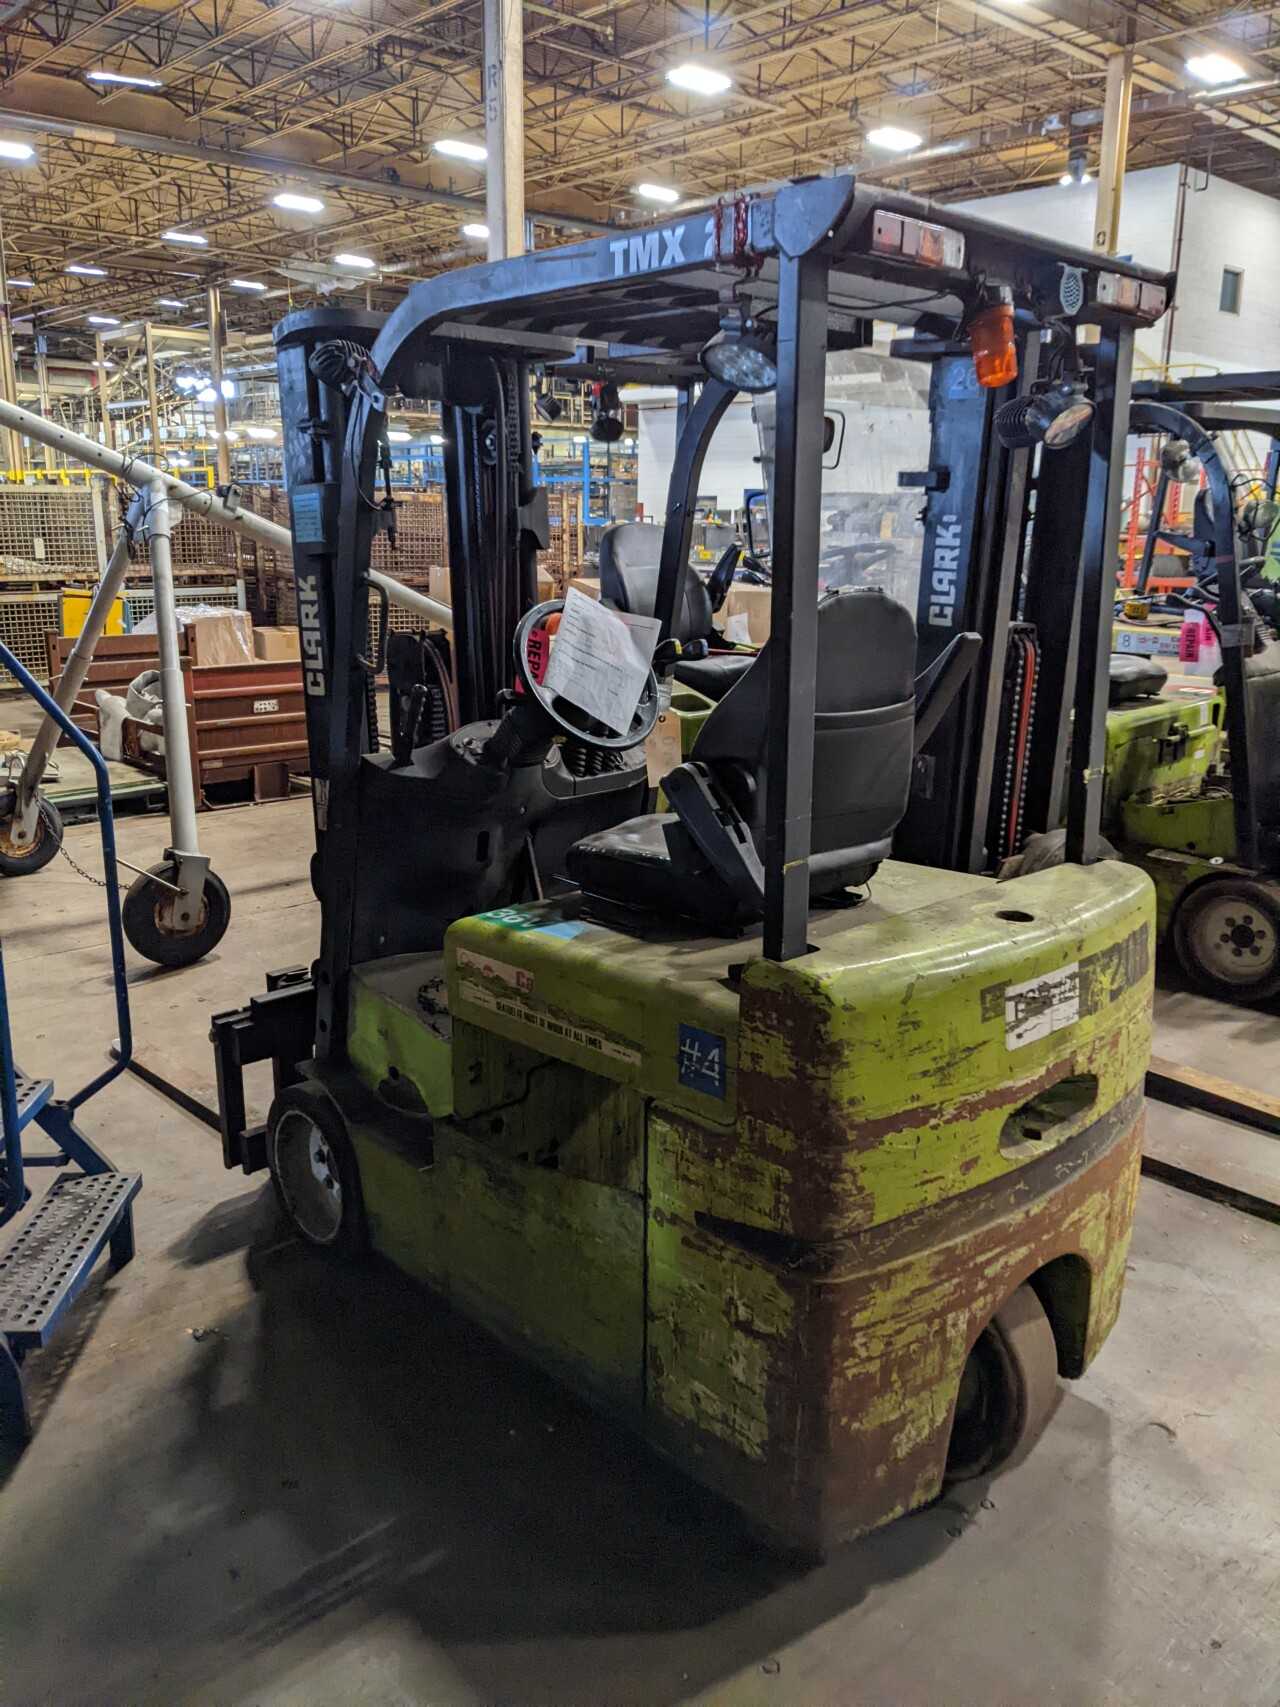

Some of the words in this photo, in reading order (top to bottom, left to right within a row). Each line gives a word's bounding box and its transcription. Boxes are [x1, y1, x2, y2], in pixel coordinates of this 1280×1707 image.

[610, 224, 686, 277] TMX
[928, 523, 962, 628] CLARK
[298, 575, 326, 697] CLARK
